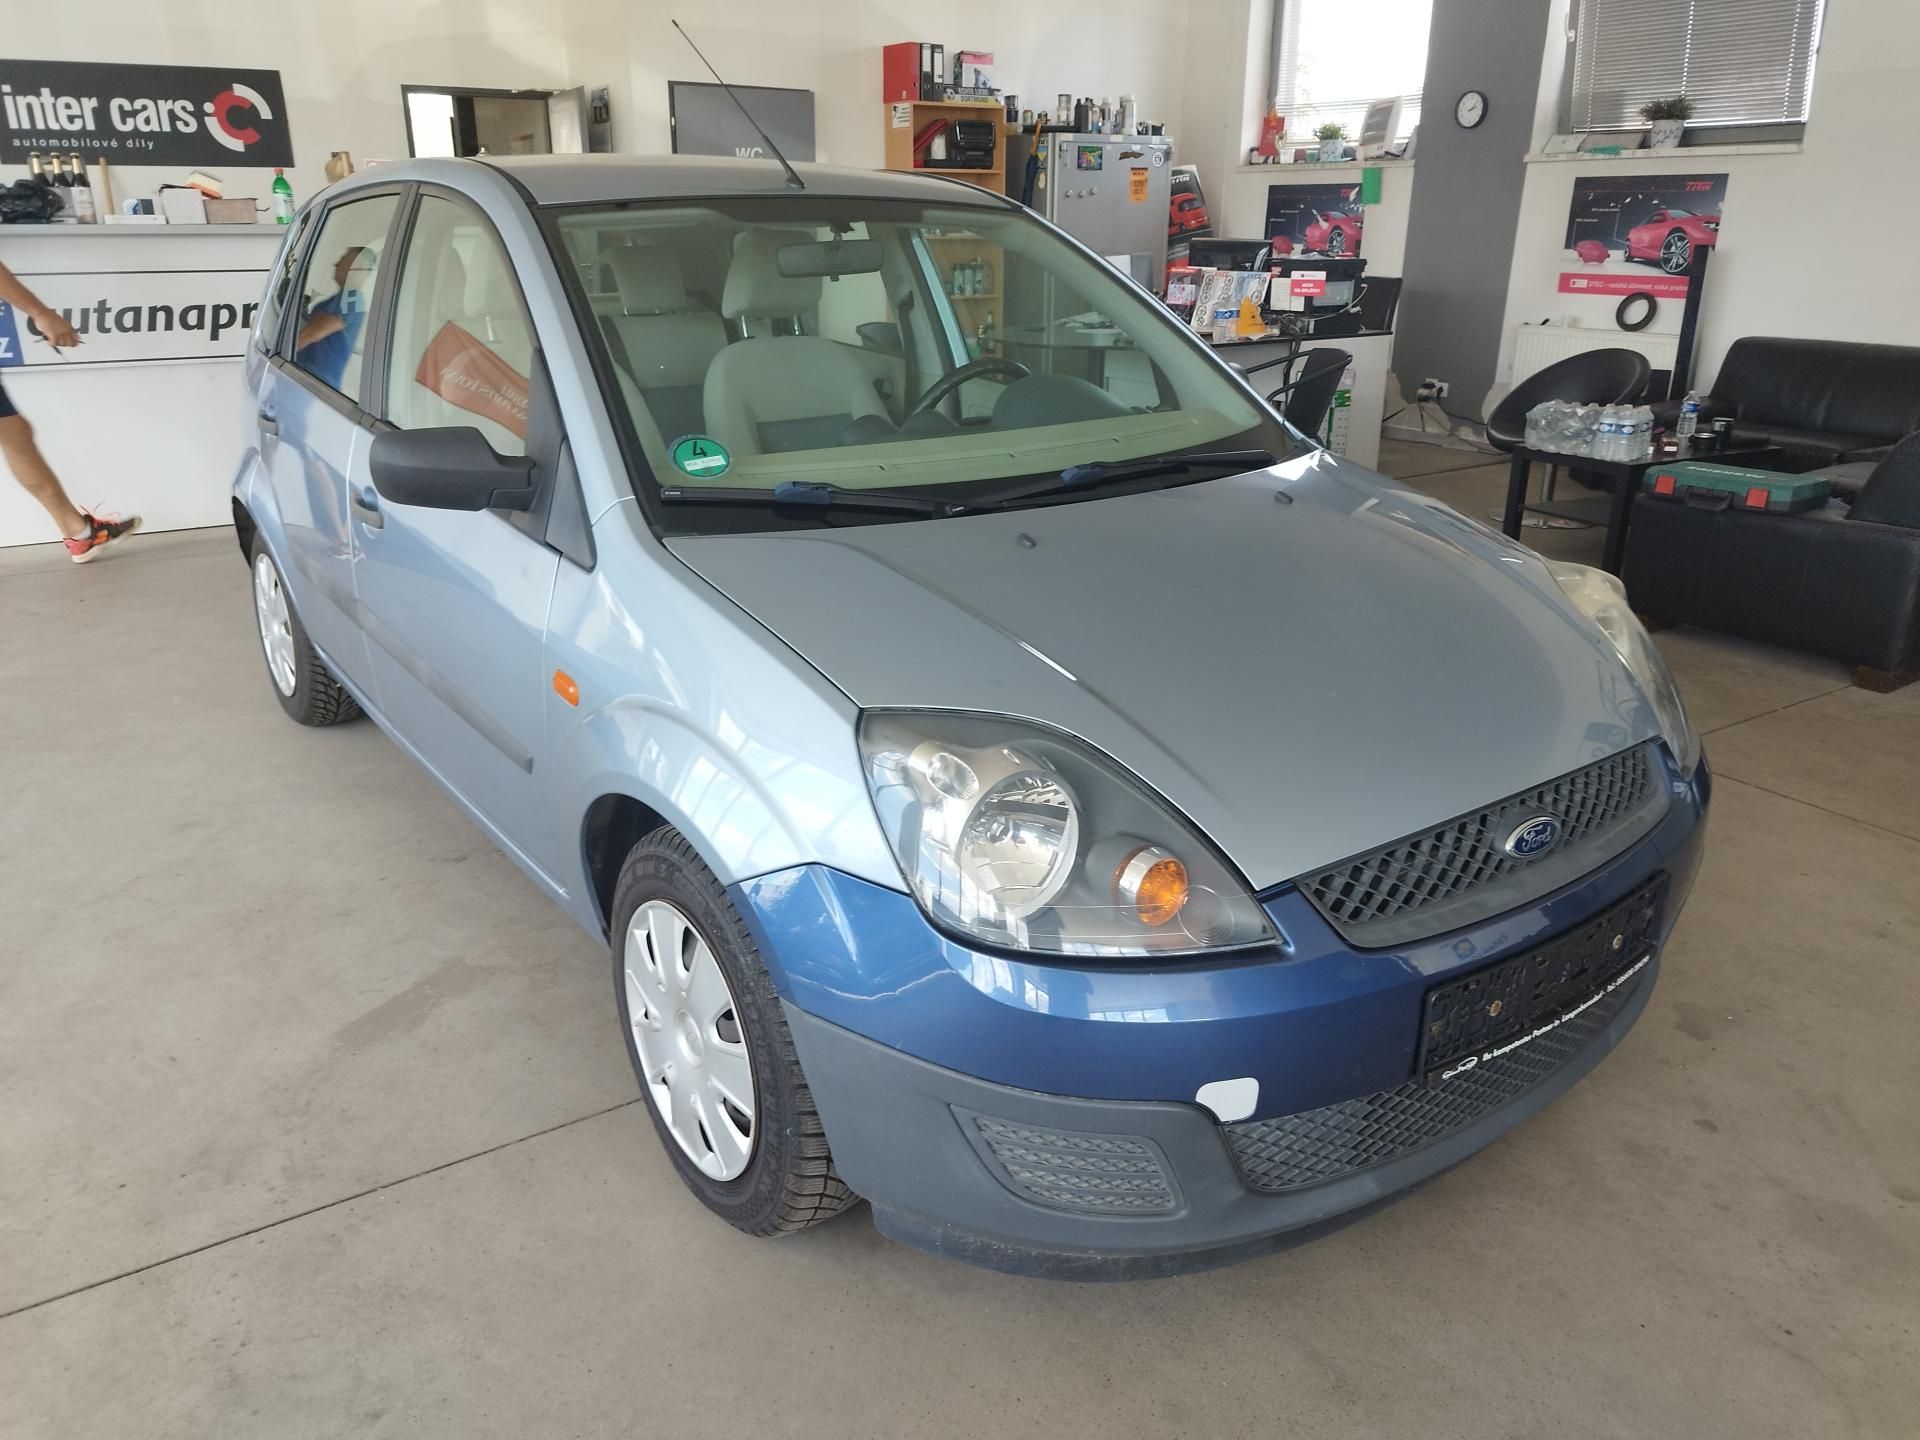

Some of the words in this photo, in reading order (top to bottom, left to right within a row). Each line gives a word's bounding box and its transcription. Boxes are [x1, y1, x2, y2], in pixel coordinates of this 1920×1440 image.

[1, 84, 98, 131] inter
[109, 97, 198, 133] cars
[12, 138, 118, 148] automobilové
[126, 137, 154, 149] díly
[736, 147, 763, 159] WC
[1685, 181, 1714, 192] TRW
[692, 440, 708, 457] 4
[1522, 824, 1552, 852] Ford
